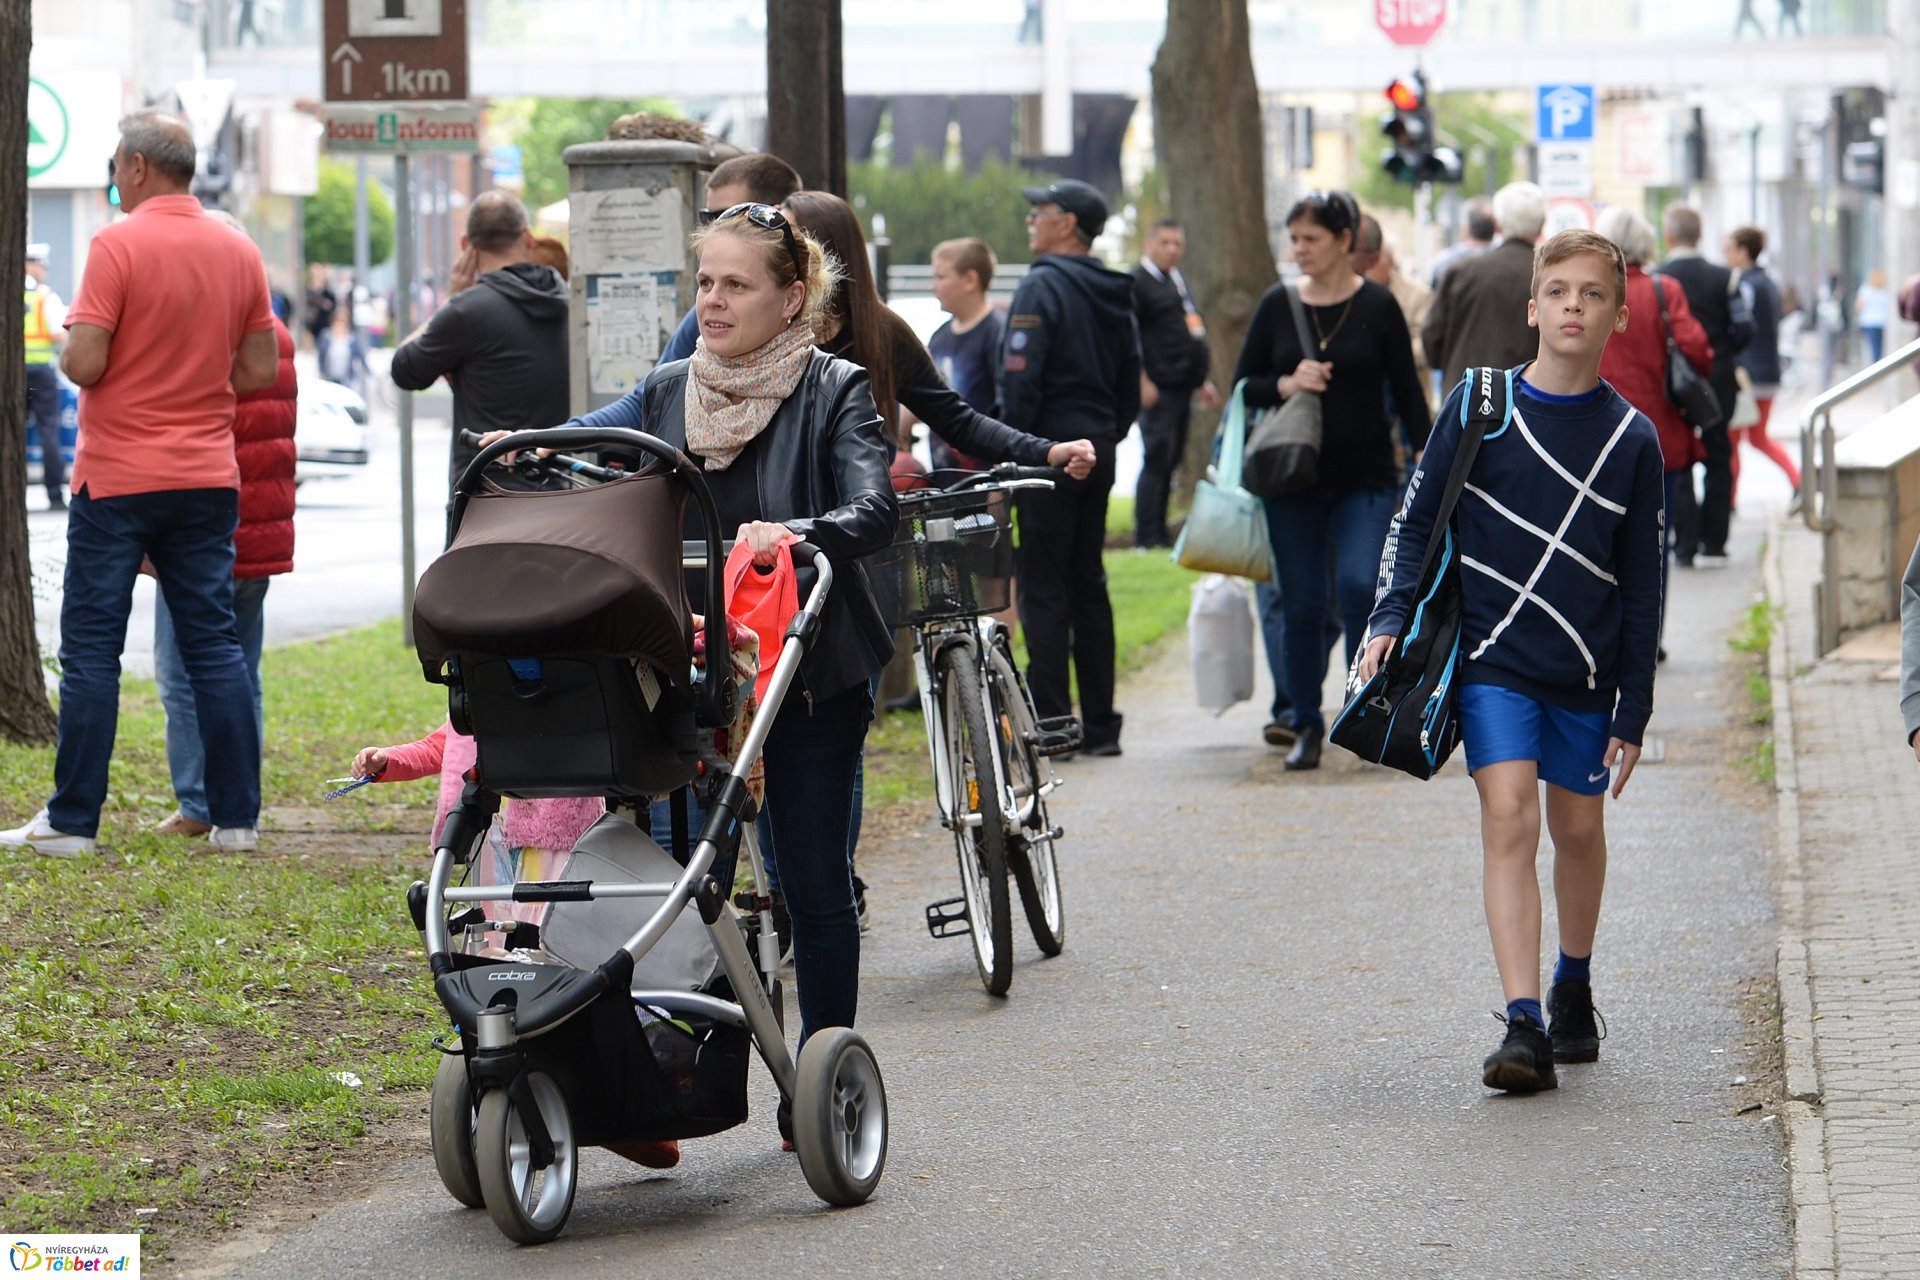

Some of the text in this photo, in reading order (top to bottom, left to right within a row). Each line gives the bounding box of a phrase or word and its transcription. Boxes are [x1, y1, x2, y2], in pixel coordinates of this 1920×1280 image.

[1380, 0, 1443, 27] STOP
[1552, 100, 1582, 137] P
[488, 970, 536, 981] cobra
